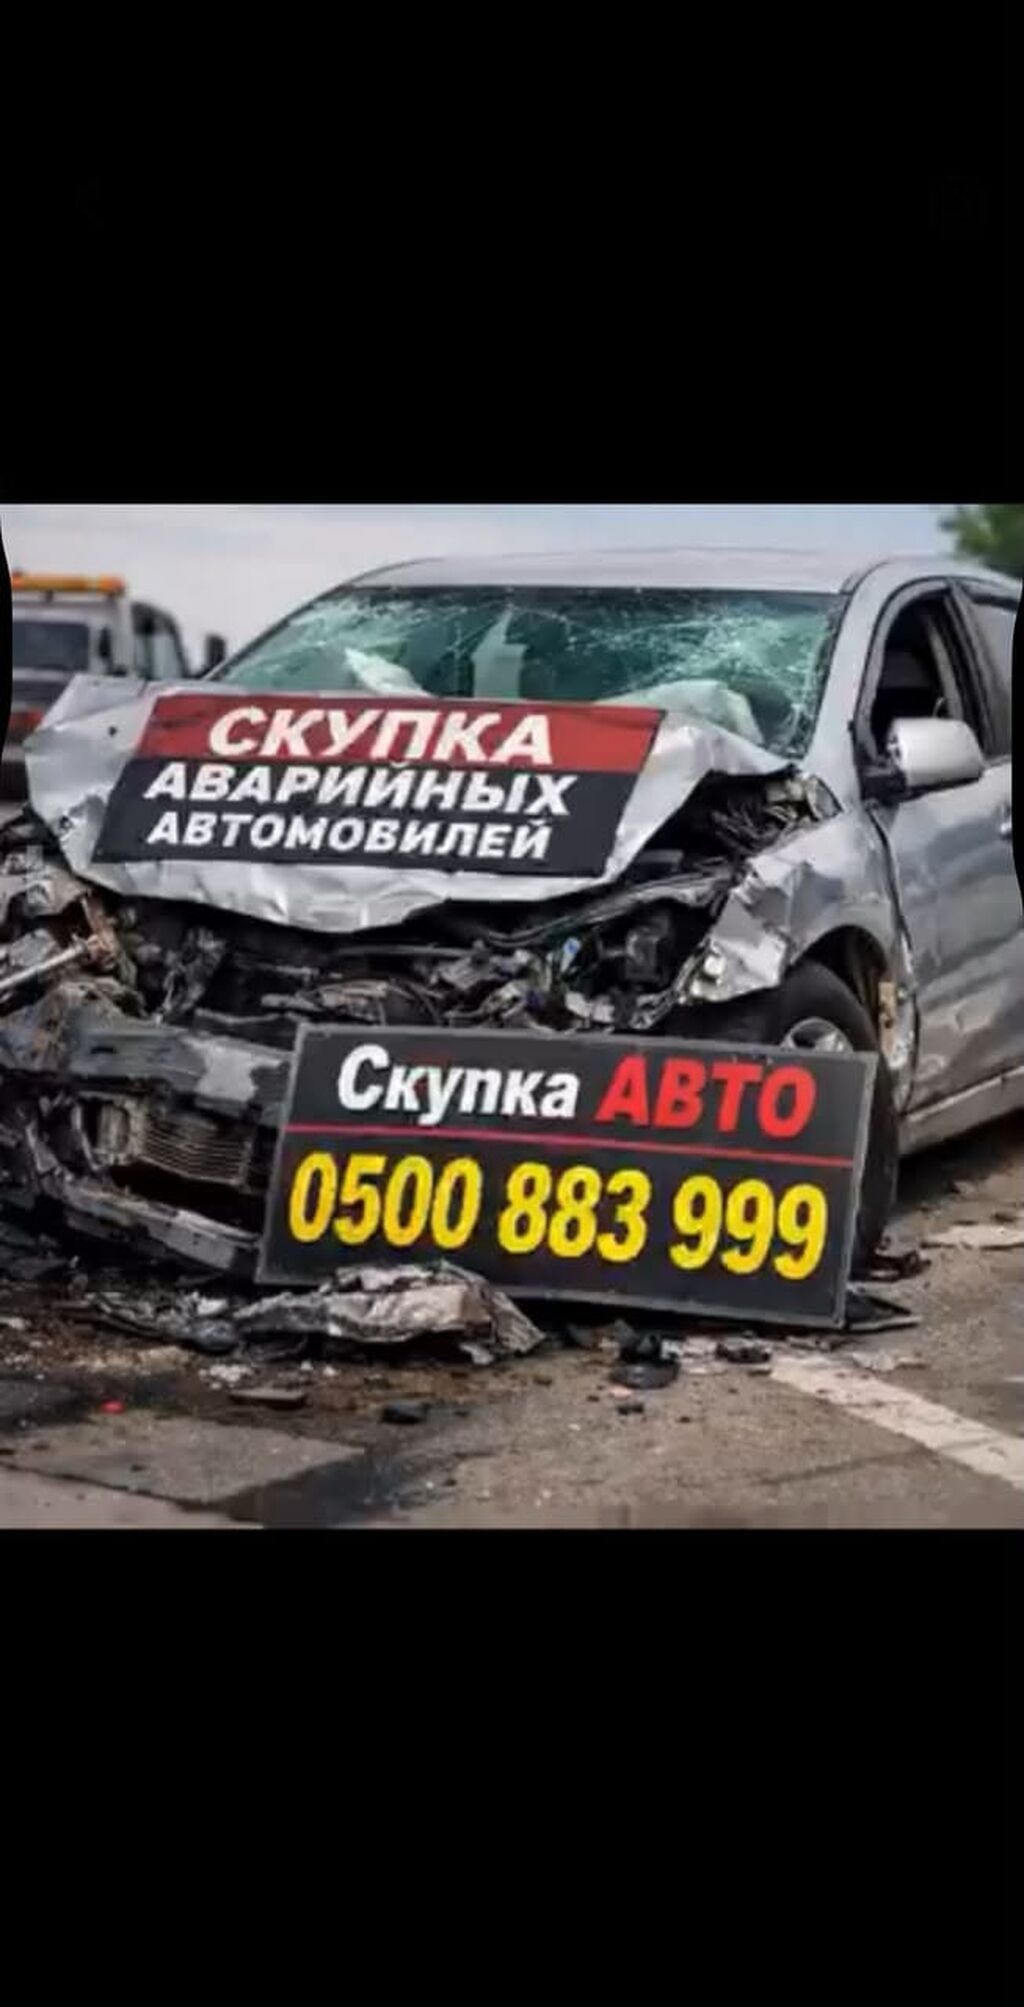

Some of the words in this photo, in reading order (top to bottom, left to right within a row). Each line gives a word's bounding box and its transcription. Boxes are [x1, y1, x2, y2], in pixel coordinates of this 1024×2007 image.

[208, 706, 553, 765] СКУПКА
[143, 762, 578, 816] АВАРИЙНЫХ
[337, 1044, 580, 1126] Скупка
[595, 1056, 817, 1138] АВТО
[288, 1151, 483, 1248] 0500
[498, 1162, 652, 1262] 883
[669, 1175, 829, 1280] 999
